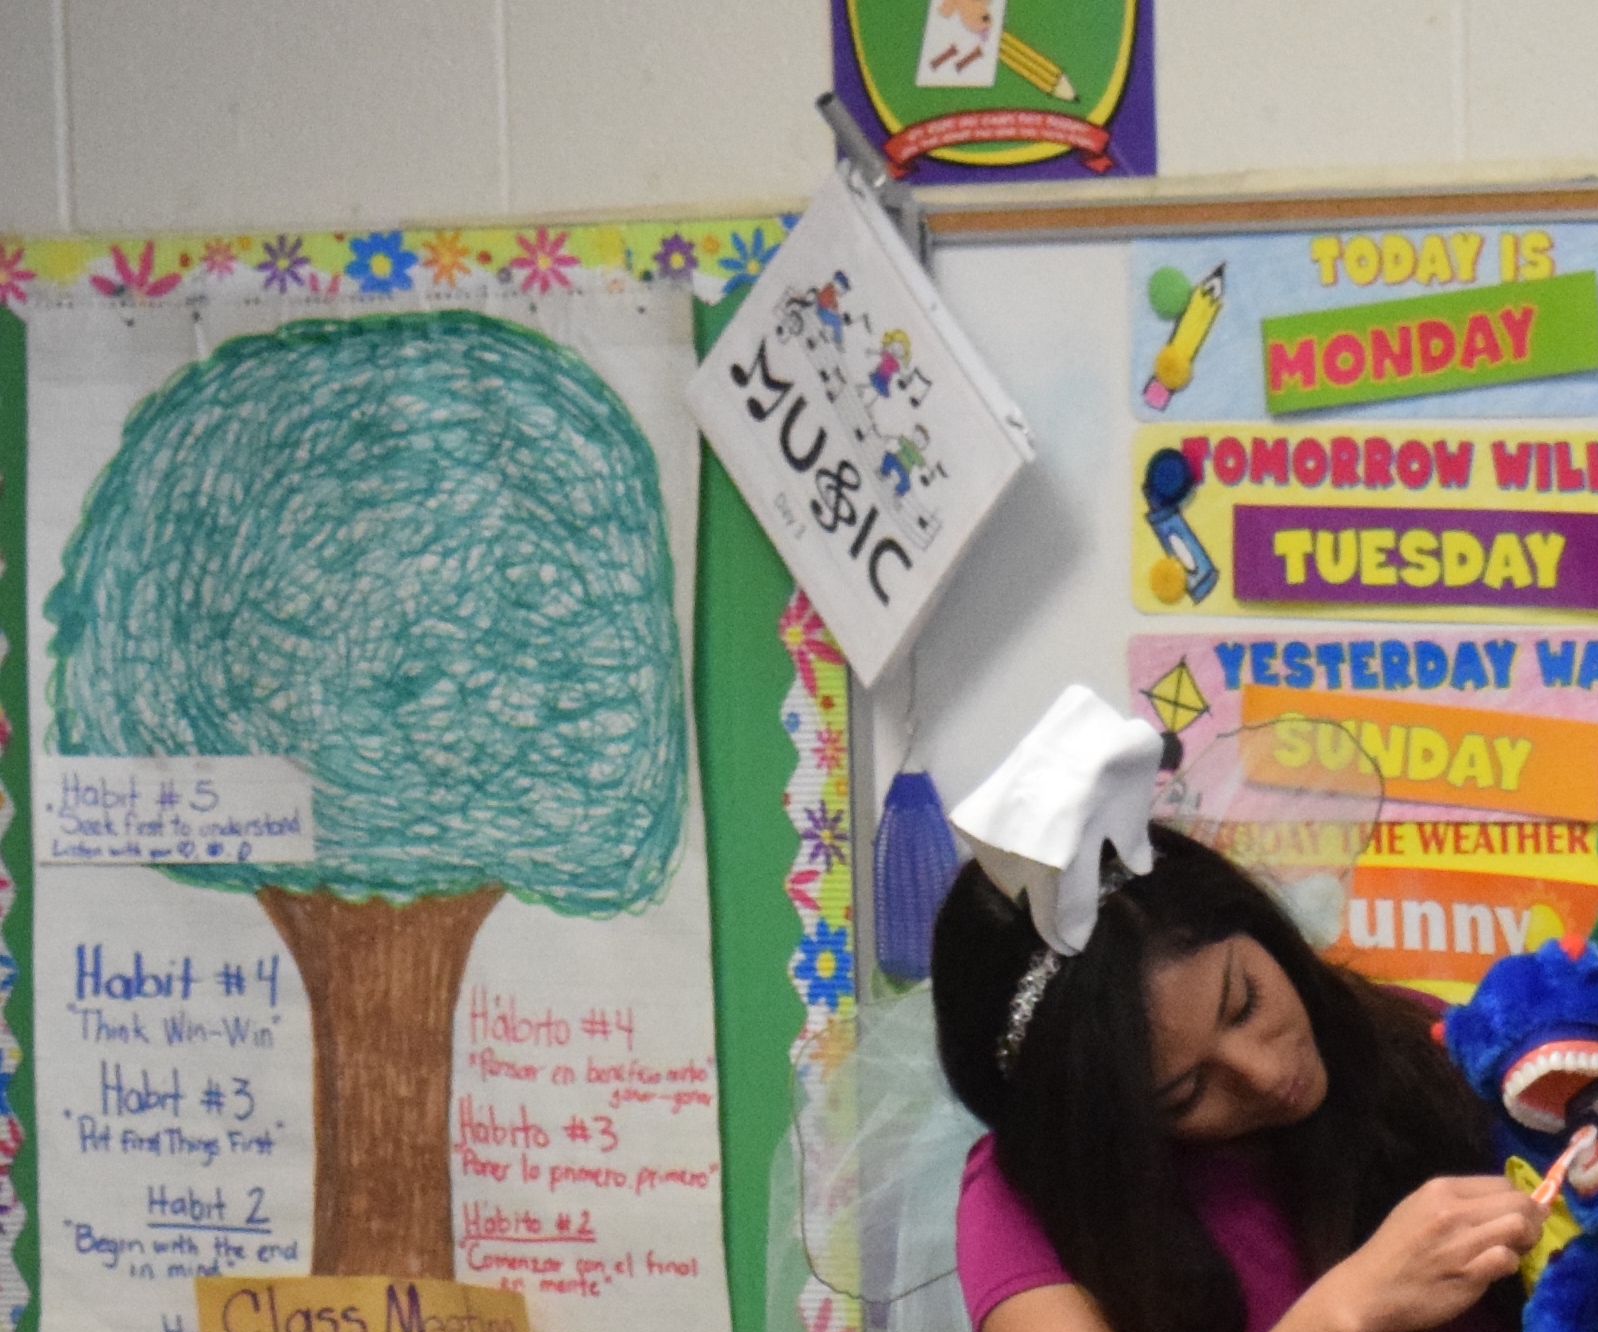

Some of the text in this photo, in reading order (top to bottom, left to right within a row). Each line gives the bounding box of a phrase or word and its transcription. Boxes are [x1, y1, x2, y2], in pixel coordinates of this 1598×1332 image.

[1310, 230, 1556, 289] TODAY IS
[1267, 304, 1537, 394] MONDAY
[1179, 434, 1475, 490] TOMORROW
[1273, 527, 1567, 591] TUESDAY
[1215, 638, 1518, 693] YESTERDAY
[1273, 711, 1534, 791] SUNDAY
[61, 772, 138, 808] Habit
[1416, 820, 1590, 855] WEATHER
[1349, 898, 1531, 955] unny
[75, 943, 200, 1001] Habit
[101, 1060, 185, 1117] Habit
[148, 1184, 271, 1225] Habit 2
[462, 1200, 542, 1236] Habito
[130, 1263, 155, 1279] in
[153, 1234, 198, 1255] with
[214, 1237, 245, 1259] the
[257, 1241, 298, 1263] end
[646, 1249, 698, 1278] final
